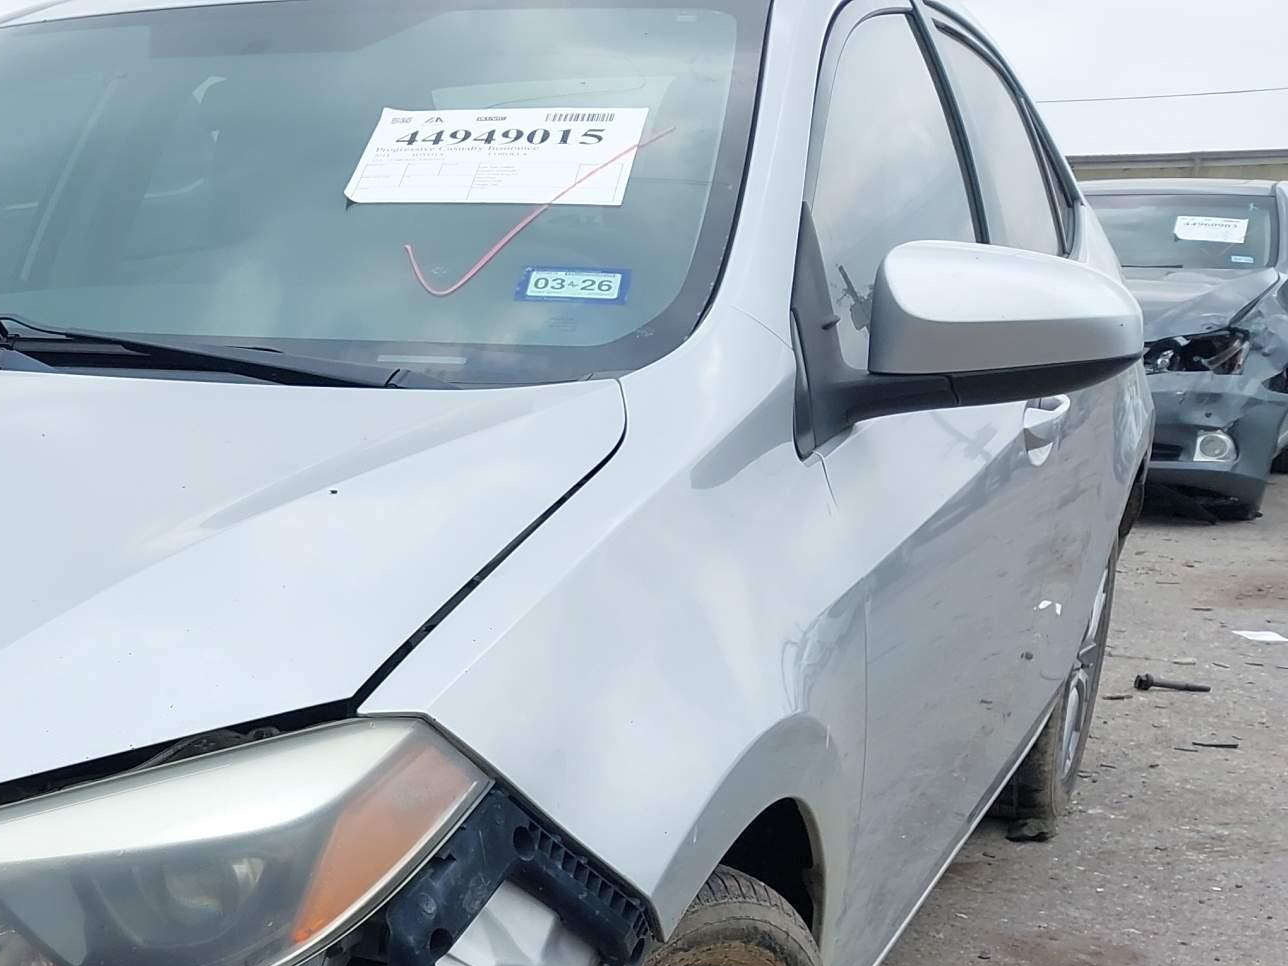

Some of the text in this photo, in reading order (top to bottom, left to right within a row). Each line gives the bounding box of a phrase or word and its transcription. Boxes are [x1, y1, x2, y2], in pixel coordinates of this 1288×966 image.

[395, 128, 606, 146] 44949015
[533, 277, 613, 292] 03 26
